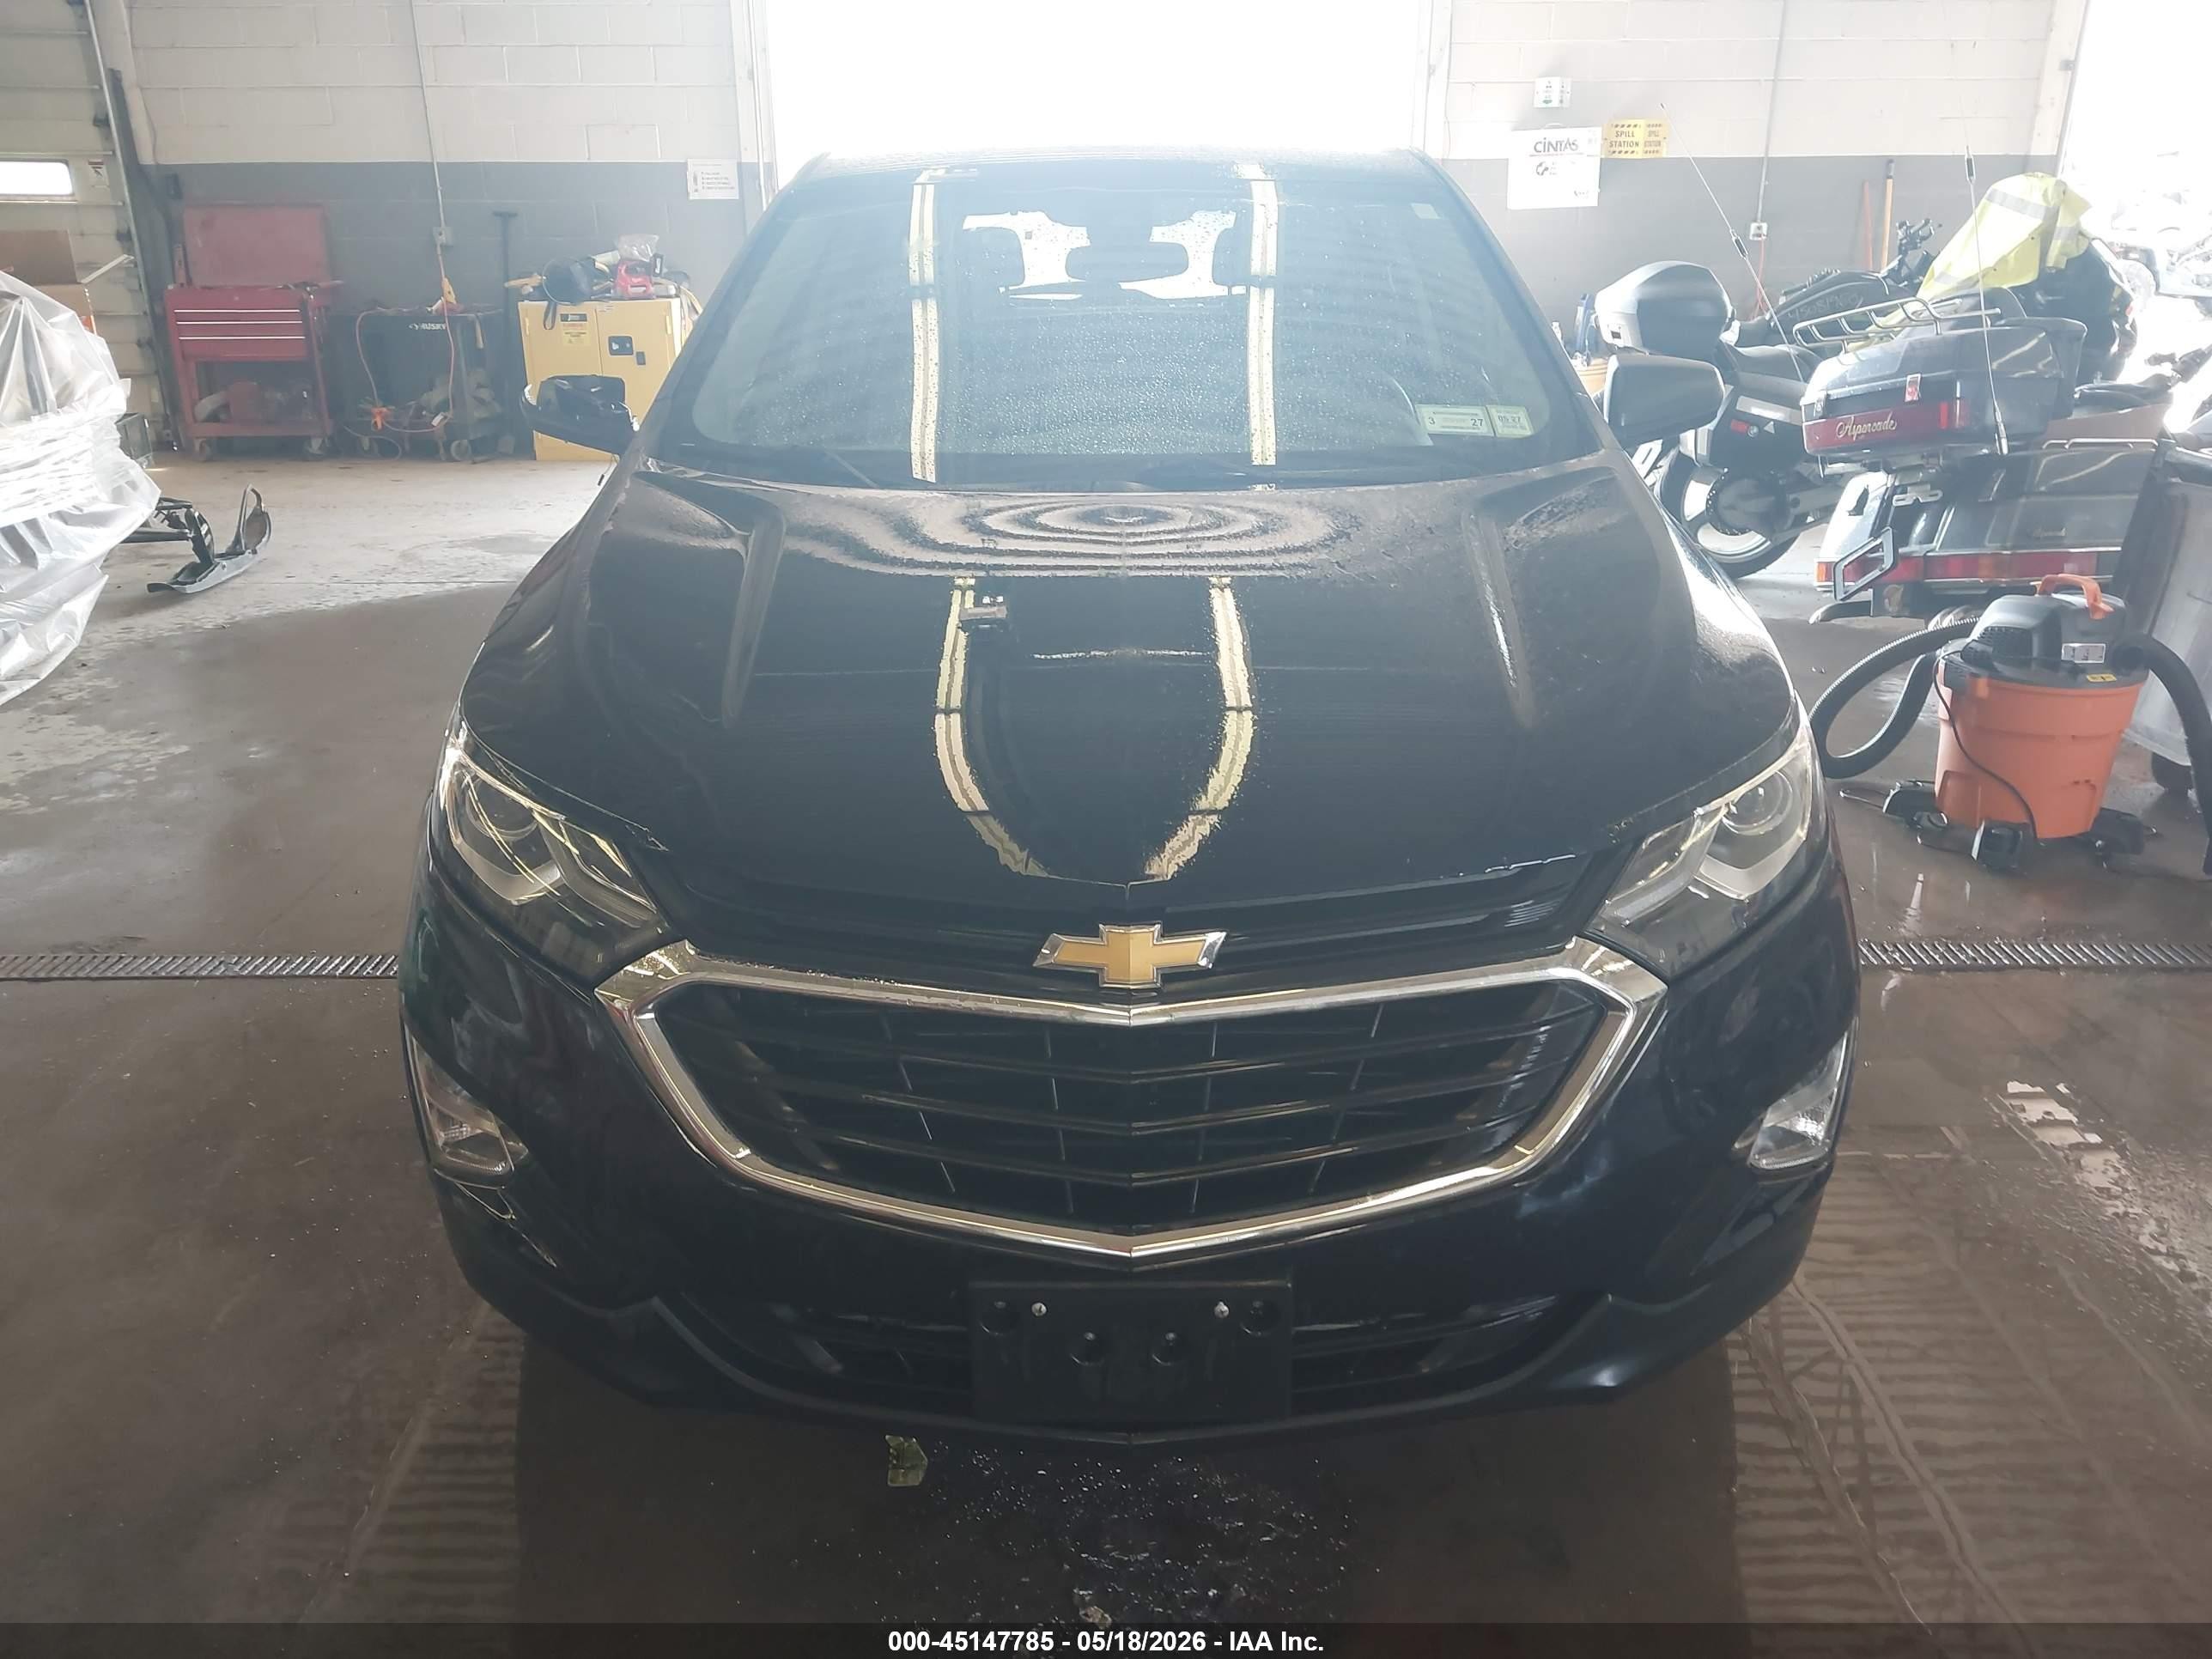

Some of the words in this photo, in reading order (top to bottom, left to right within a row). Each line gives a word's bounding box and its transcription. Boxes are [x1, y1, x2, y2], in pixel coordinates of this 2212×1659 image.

[1609, 140, 1639, 149] STATION
[1428, 416, 1436, 425] 3
[1470, 418, 1484, 427] 27
